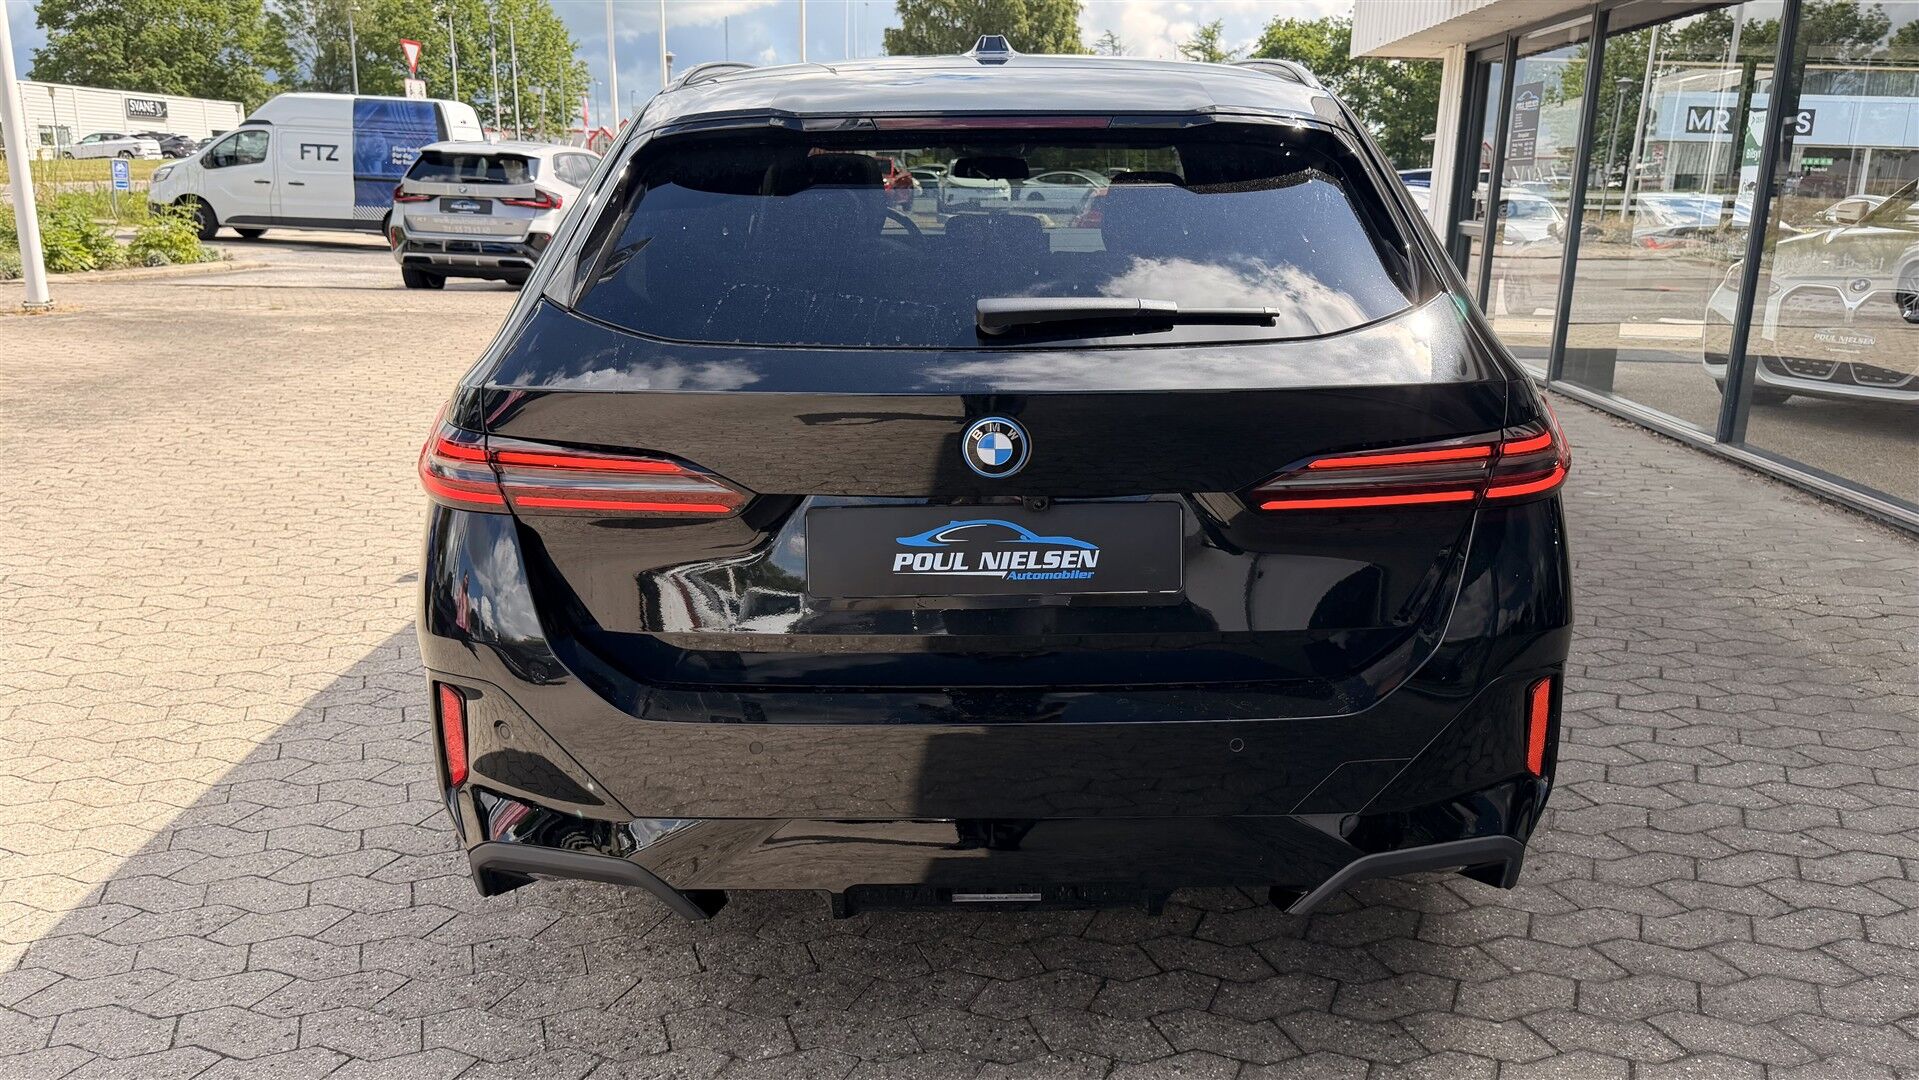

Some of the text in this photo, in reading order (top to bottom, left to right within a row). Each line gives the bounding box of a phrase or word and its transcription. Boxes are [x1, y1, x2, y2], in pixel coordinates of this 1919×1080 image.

[130, 99, 156, 113] SVANE
[300, 143, 339, 161] FTZ
[971, 422, 1019, 441] BMW
[892, 550, 1100, 572] POUL NIELSEN
[1007, 570, 1095, 581] Automobiler
